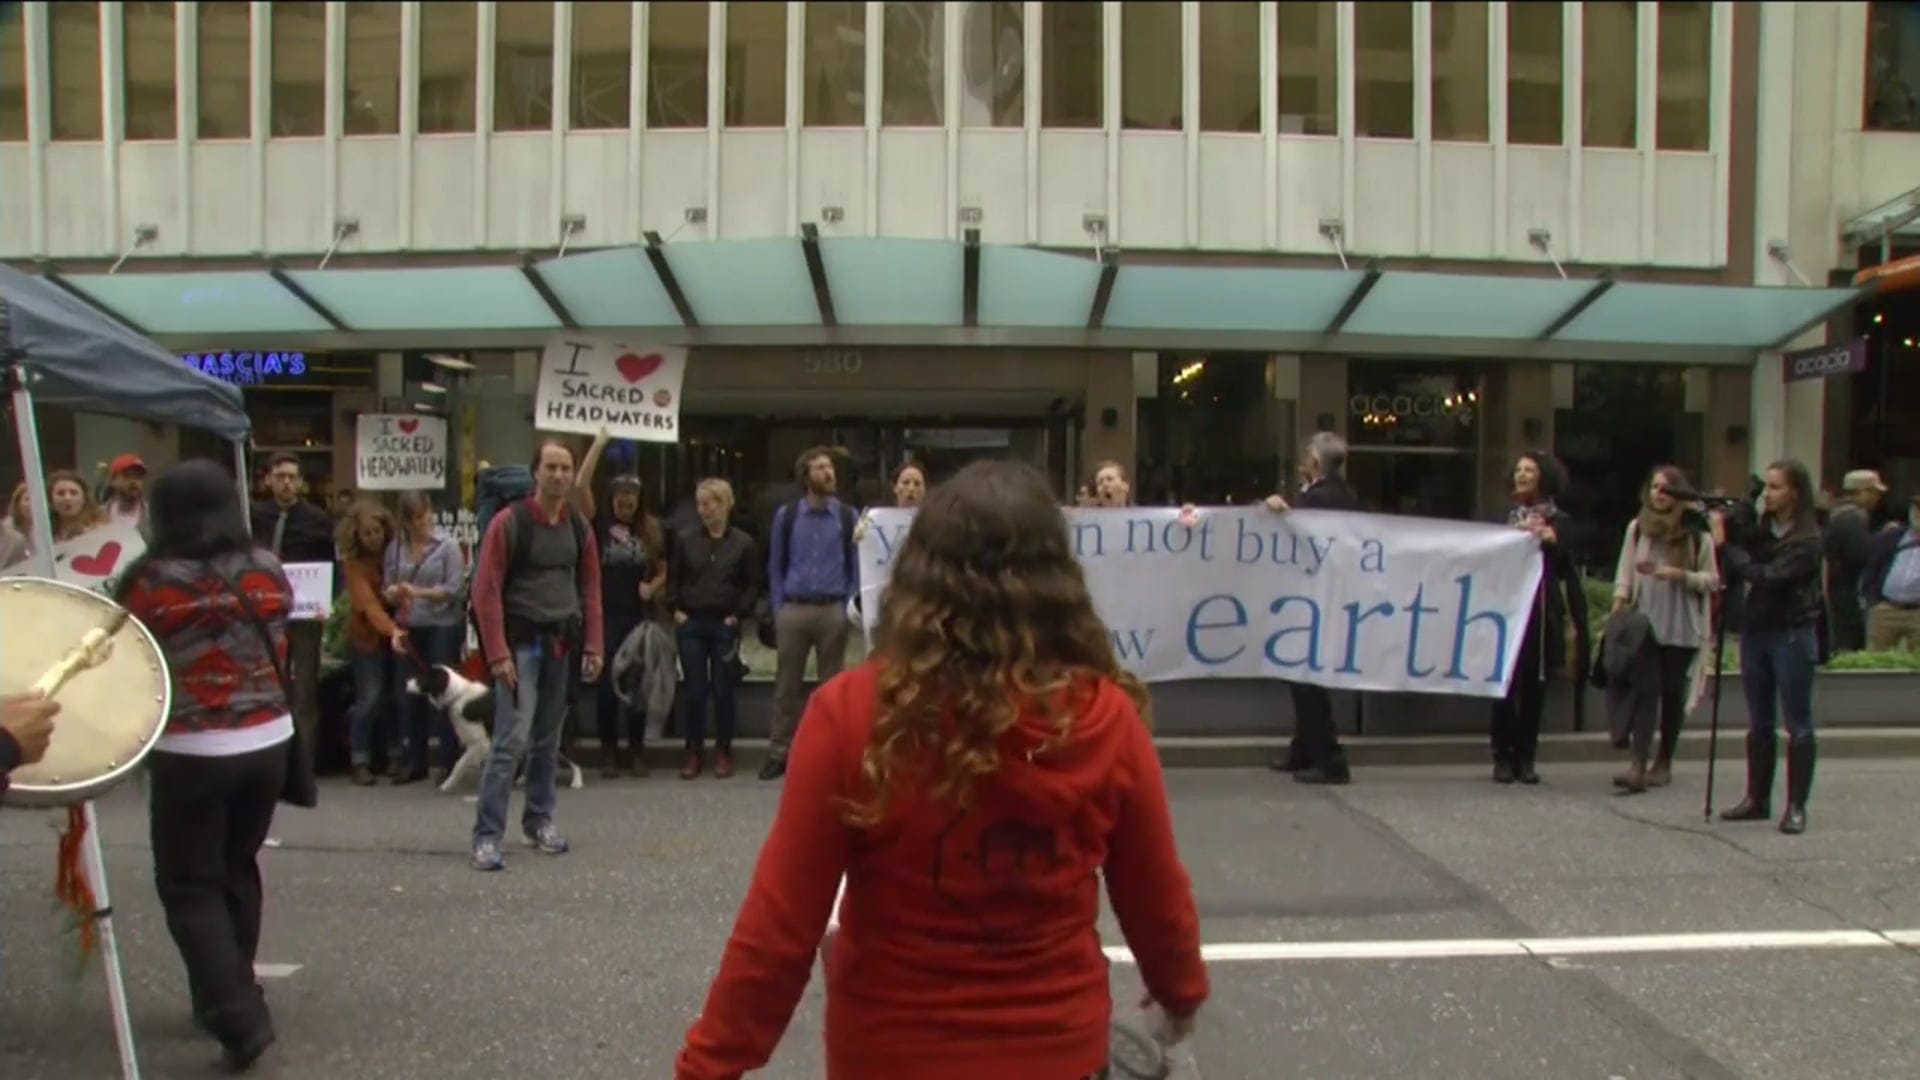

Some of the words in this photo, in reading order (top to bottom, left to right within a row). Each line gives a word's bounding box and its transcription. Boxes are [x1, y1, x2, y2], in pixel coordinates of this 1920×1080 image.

[554, 341, 594, 376] I
[803, 350, 862, 374] 580
[1795, 345, 1851, 376] acacia
[562, 379, 644, 404] SACRED
[379, 418, 393, 435] I
[546, 401, 674, 430] HEADWATERS
[372, 436, 434, 454] SACRED
[360, 455, 445, 480] HEADWATERS
[1126, 516, 1214, 562] not
[1236, 517, 1336, 576] buy
[1359, 537, 1387, 574] a
[1185, 573, 1509, 683] earth
